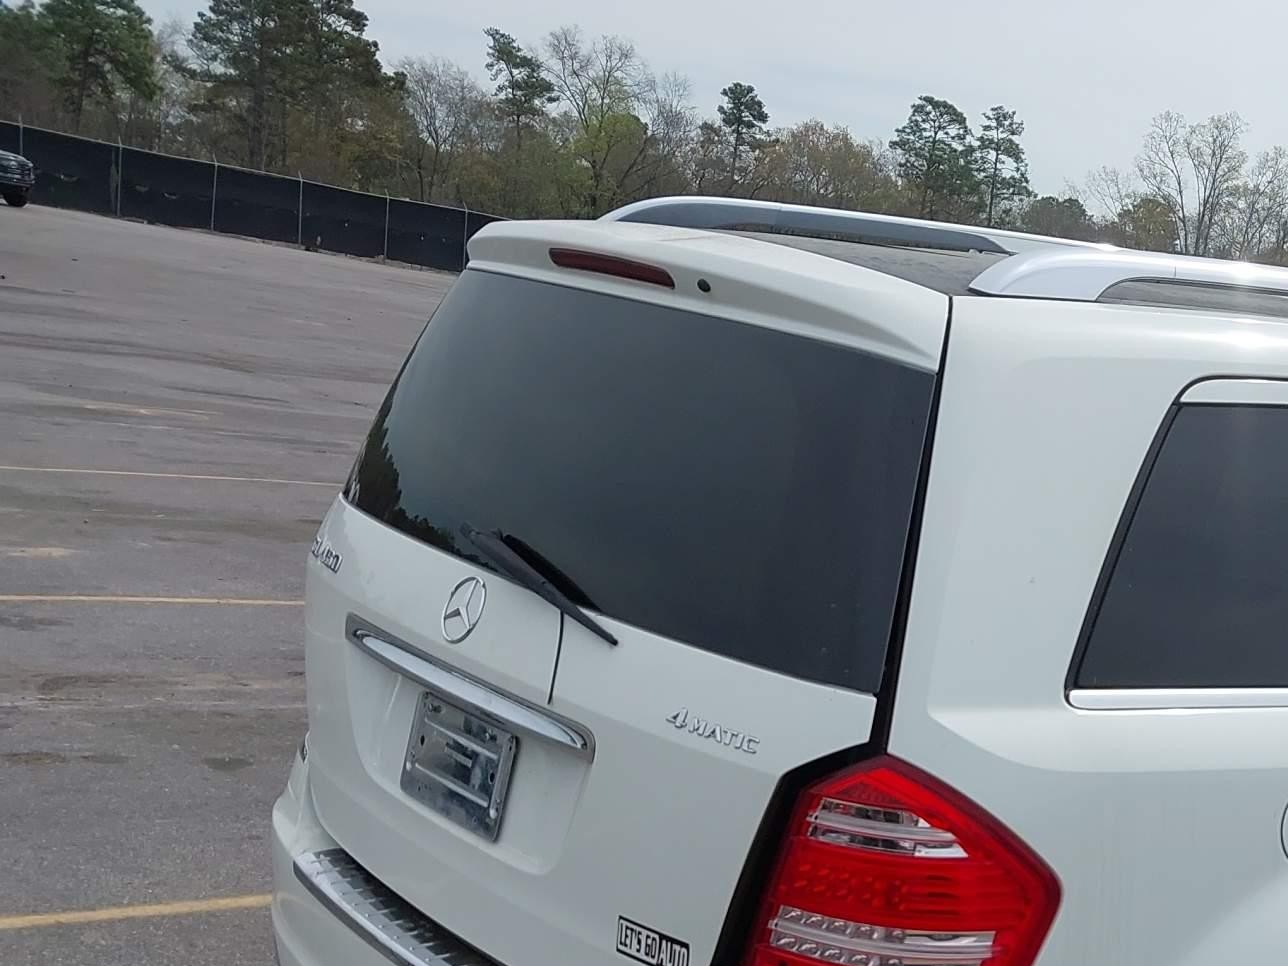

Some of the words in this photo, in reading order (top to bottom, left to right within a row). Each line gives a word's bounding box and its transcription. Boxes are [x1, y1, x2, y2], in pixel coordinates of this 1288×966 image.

[665, 707, 760, 754] 4MATIC
[619, 922, 643, 953] LET'S
[644, 933, 658, 960] GO
